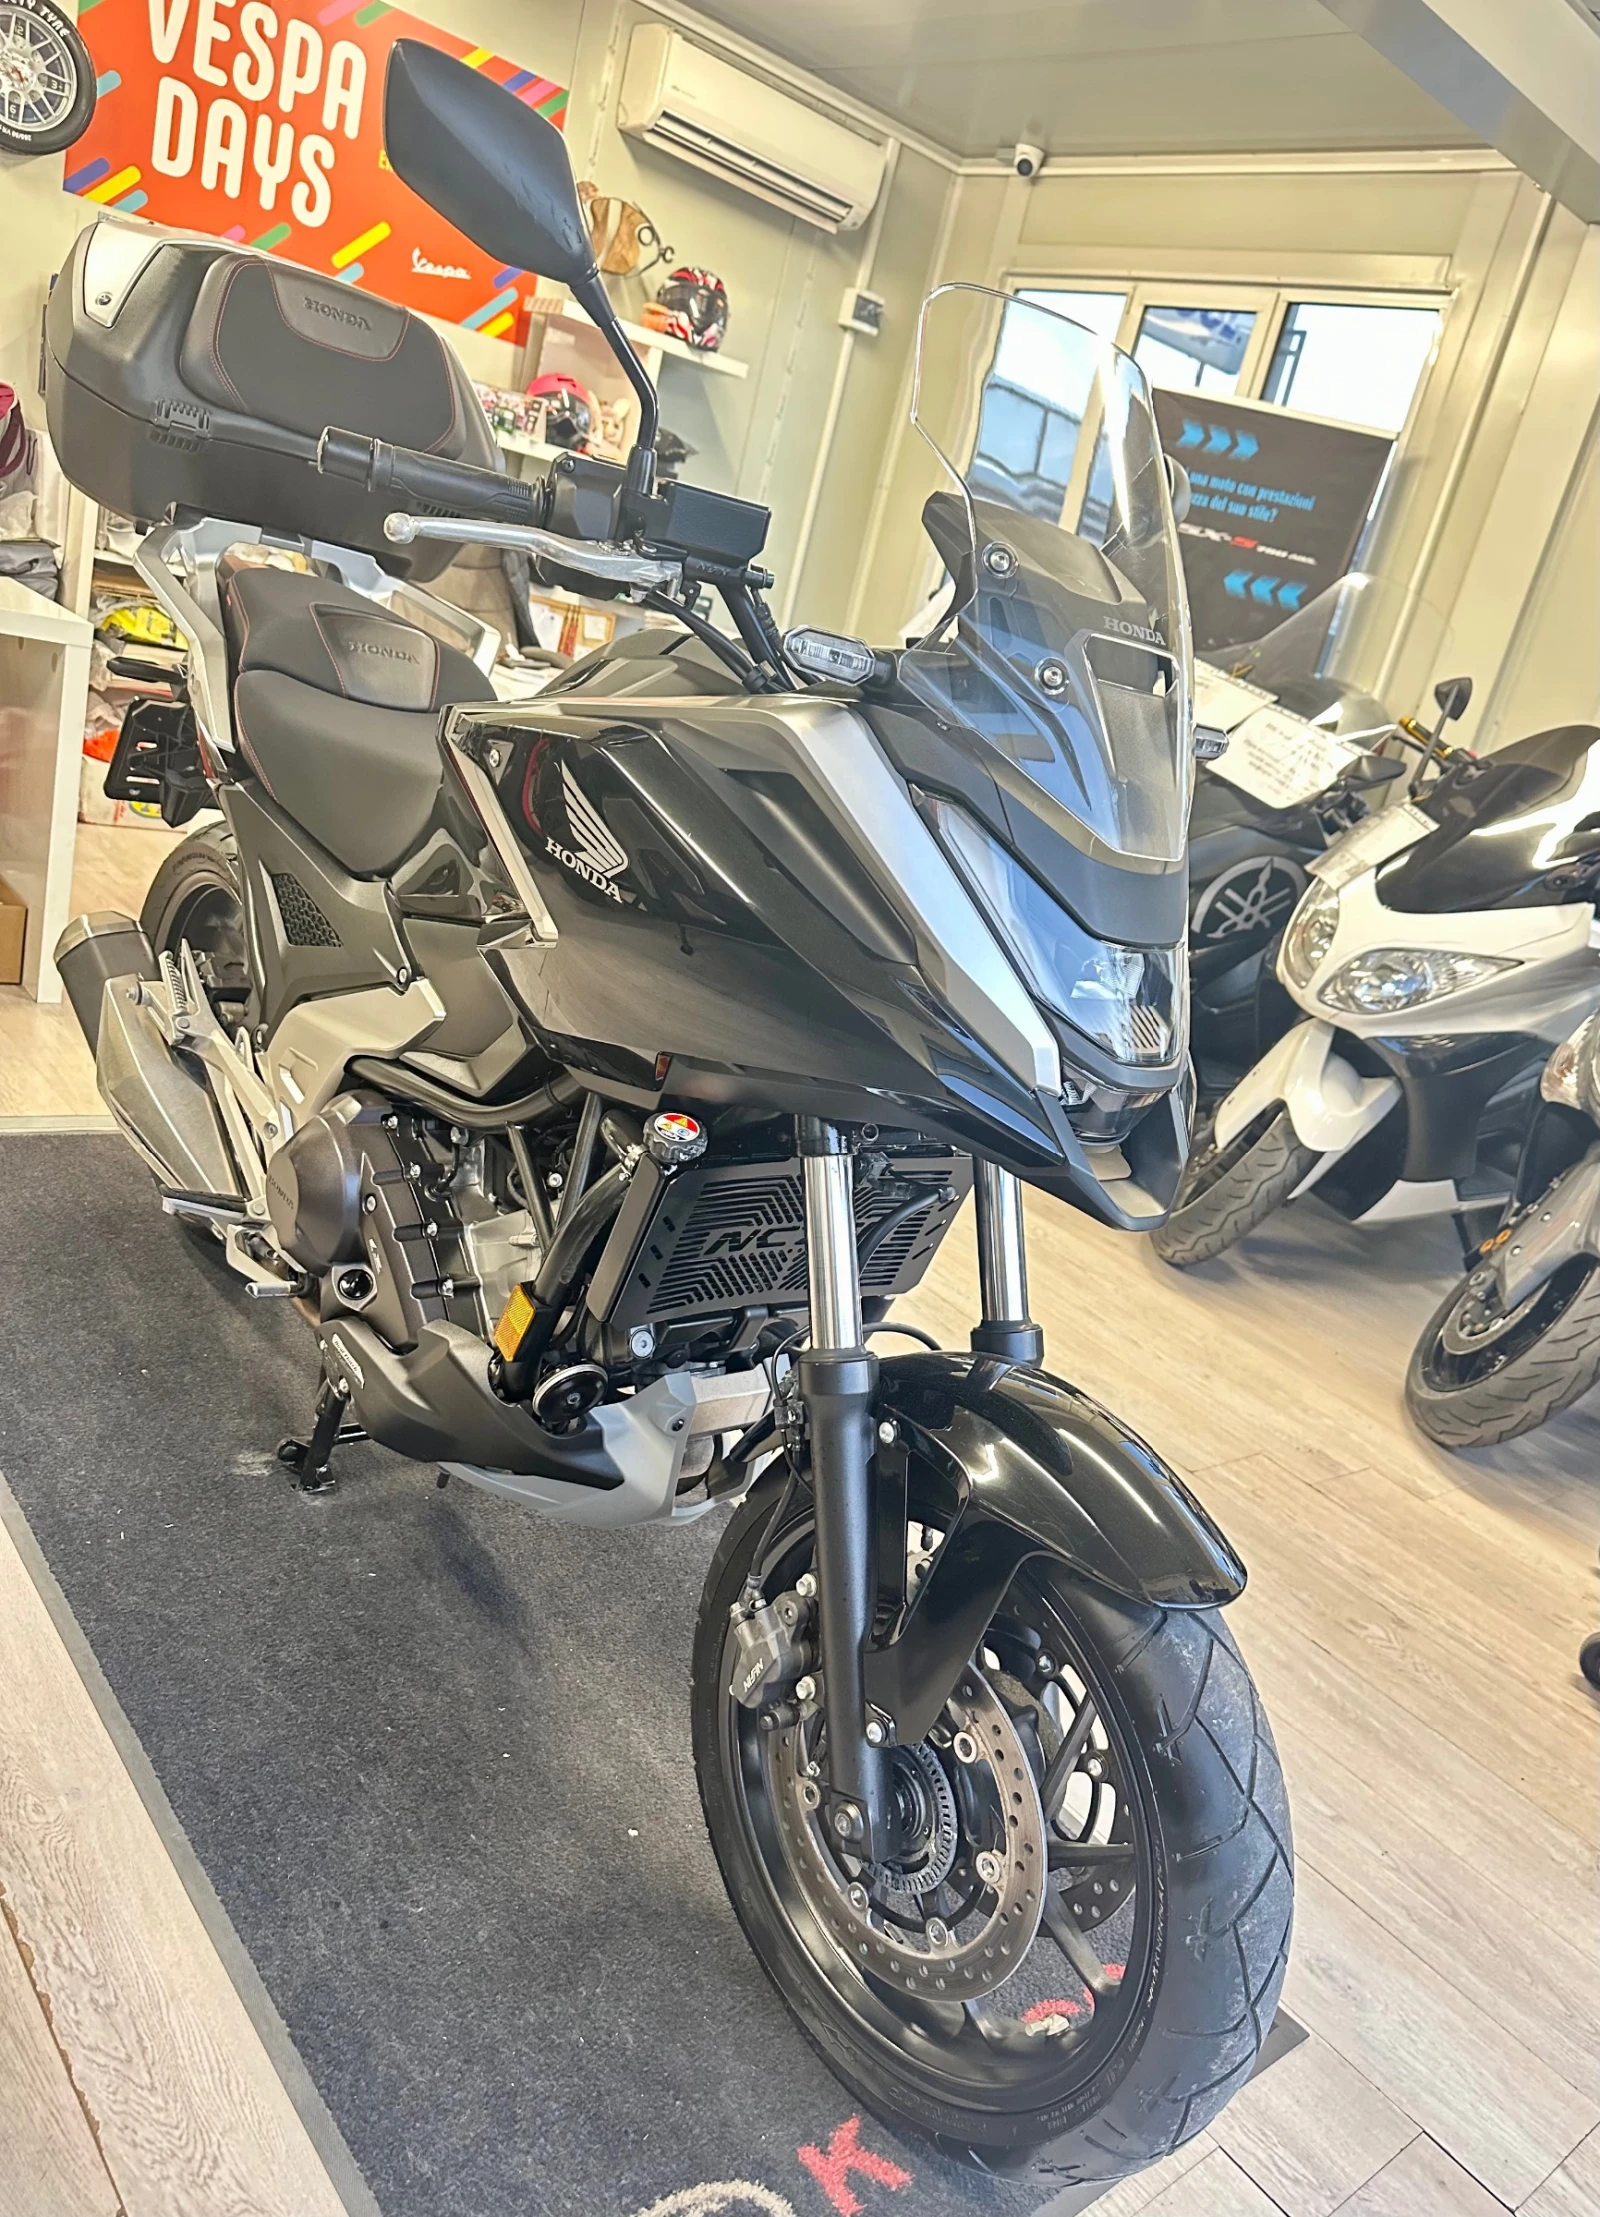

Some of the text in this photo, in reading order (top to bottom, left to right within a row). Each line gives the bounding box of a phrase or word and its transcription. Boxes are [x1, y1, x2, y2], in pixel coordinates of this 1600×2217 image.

[40, 4, 71, 37] TYRE
[148, 0, 367, 140] VESPA
[151, 76, 335, 228] DAYS
[411, 246, 472, 280] Vespa
[304, 296, 372, 331] HONDA
[1190, 472, 1317, 511] una moto con prestazioni
[1210, 495, 1228, 511] del
[1227, 502, 1247, 517] suo
[1103, 615, 1166, 646] HONDA
[348, 641, 420, 664] HONDA
[545, 836, 623, 904] HONDA
[267, 1174, 294, 1211] HONDA
[703, 1225, 808, 1256] NC
